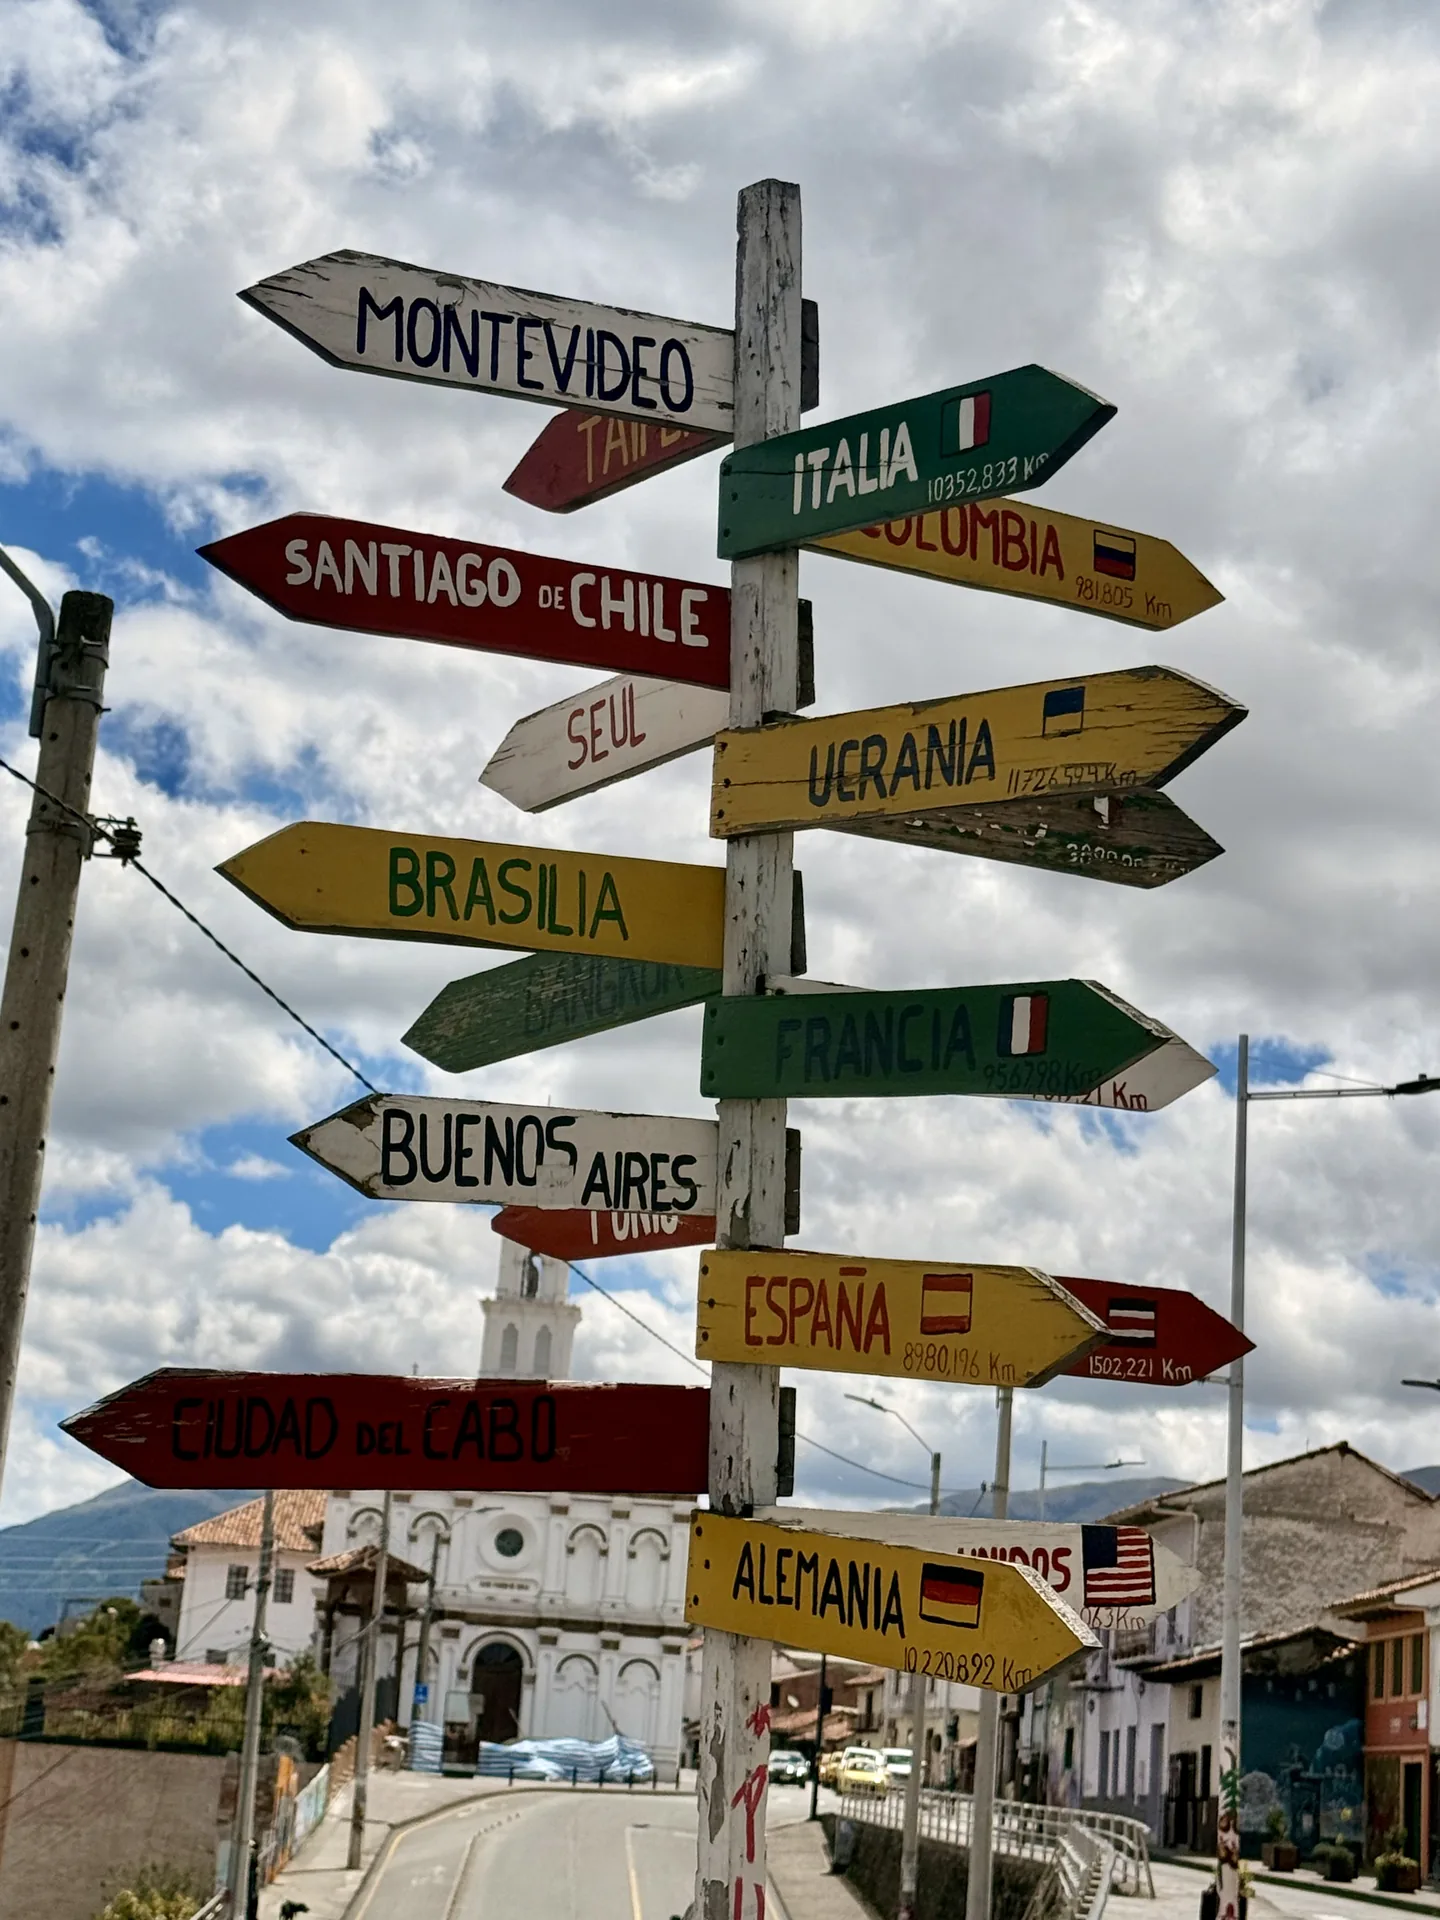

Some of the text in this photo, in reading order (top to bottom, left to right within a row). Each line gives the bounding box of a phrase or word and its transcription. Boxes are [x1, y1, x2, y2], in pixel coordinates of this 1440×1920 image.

[356, 286, 694, 413] MONTEVIDEO
[791, 420, 918, 515] ITALIA
[285, 539, 709, 648] SANTIAGO DE CHILE
[1145, 592, 1172, 619] Km
[567, 681, 646, 770] SEUL
[808, 716, 996, 807] UCRANIA
[388, 847, 630, 941] BRASILIA
[775, 1003, 977, 1083] FRANCIA
[1113, 1081, 1148, 1110] Km
[381, 1108, 698, 1211] BUENOS AIRES
[744, 1266, 891, 1356] ESPAÑA
[903, 1342, 1016, 1381] 8980,196 Km
[1089, 1355, 1192, 1380] 1502,221 Km
[171, 1395, 557, 1463] CIUDAD DEL CABO
[732, 1541, 906, 1639] ALEMANIA
[1003, 1656, 1032, 1690] Km
